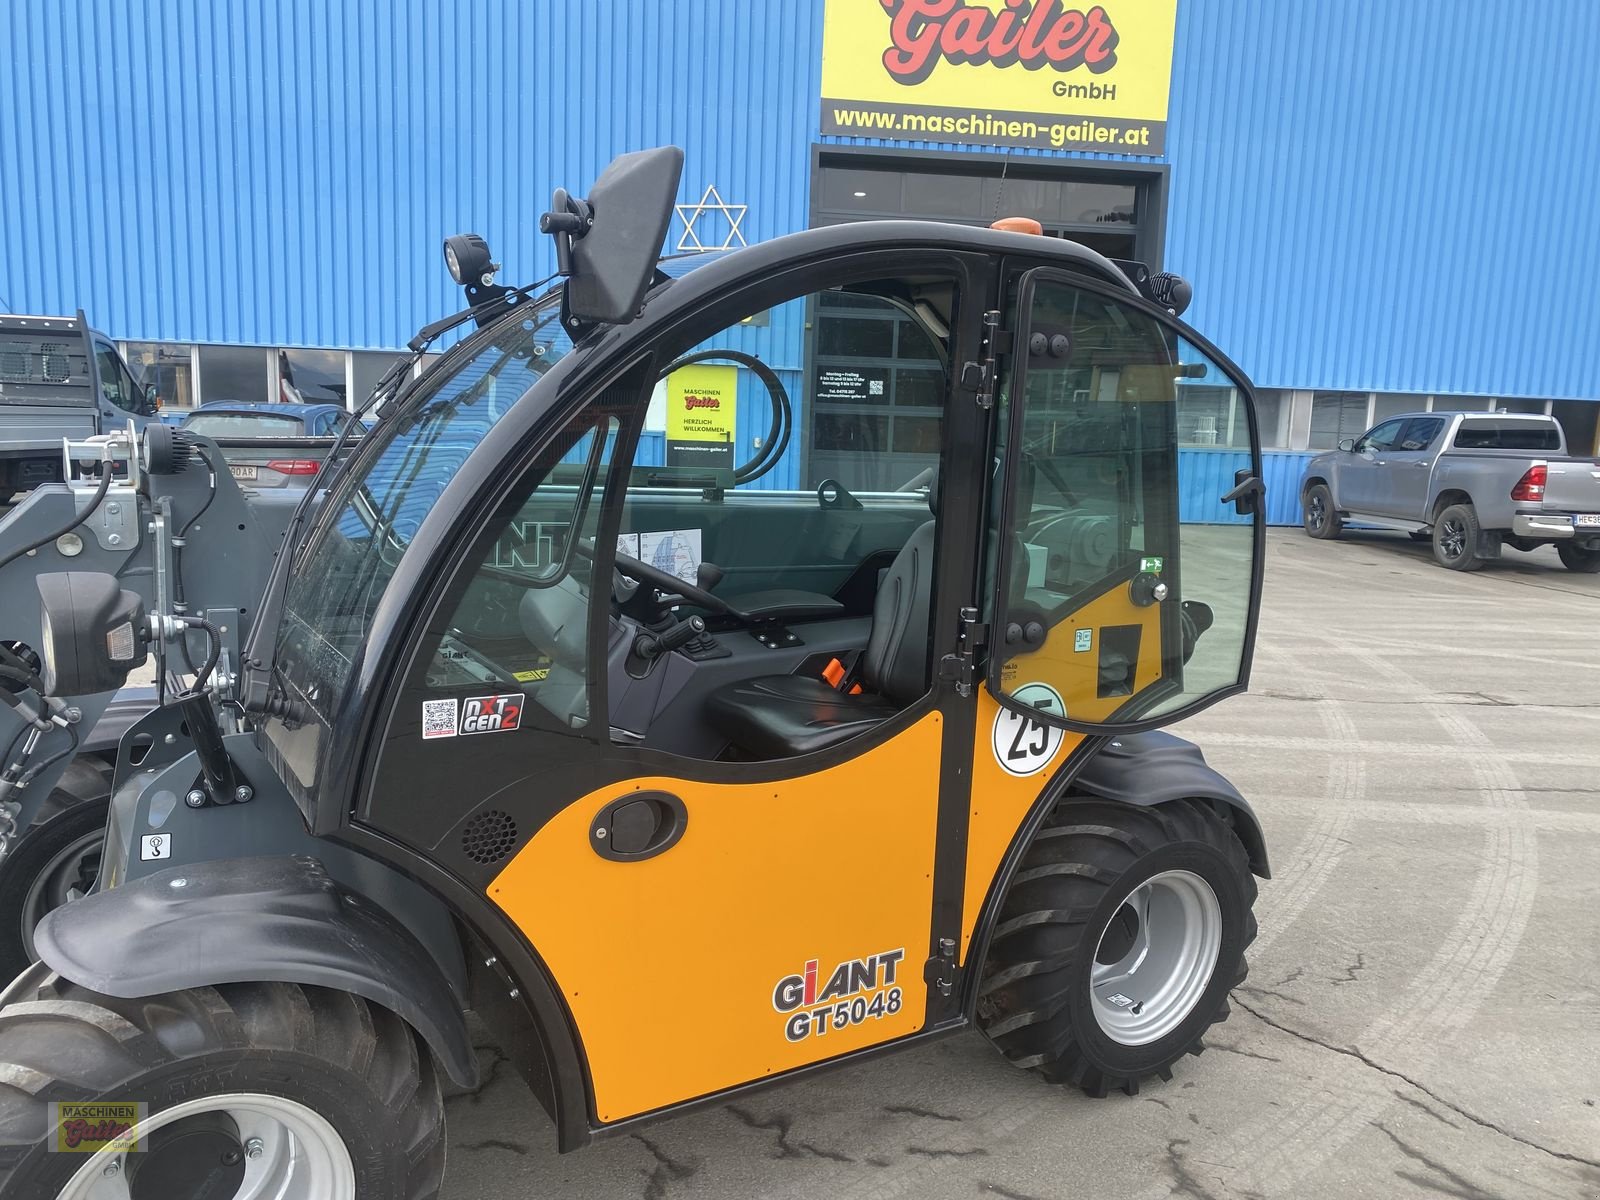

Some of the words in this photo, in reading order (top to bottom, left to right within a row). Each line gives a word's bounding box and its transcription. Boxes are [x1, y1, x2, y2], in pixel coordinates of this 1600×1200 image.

[879, 0, 1120, 86] Gailer
[1052, 80, 1117, 101] GmbH
[833, 107, 1150, 146] www.maschinen-gailer.at
[684, 396, 720, 410] Gailer
[1007, 698, 1053, 761] 25
[784, 986, 903, 1043] GT5048
